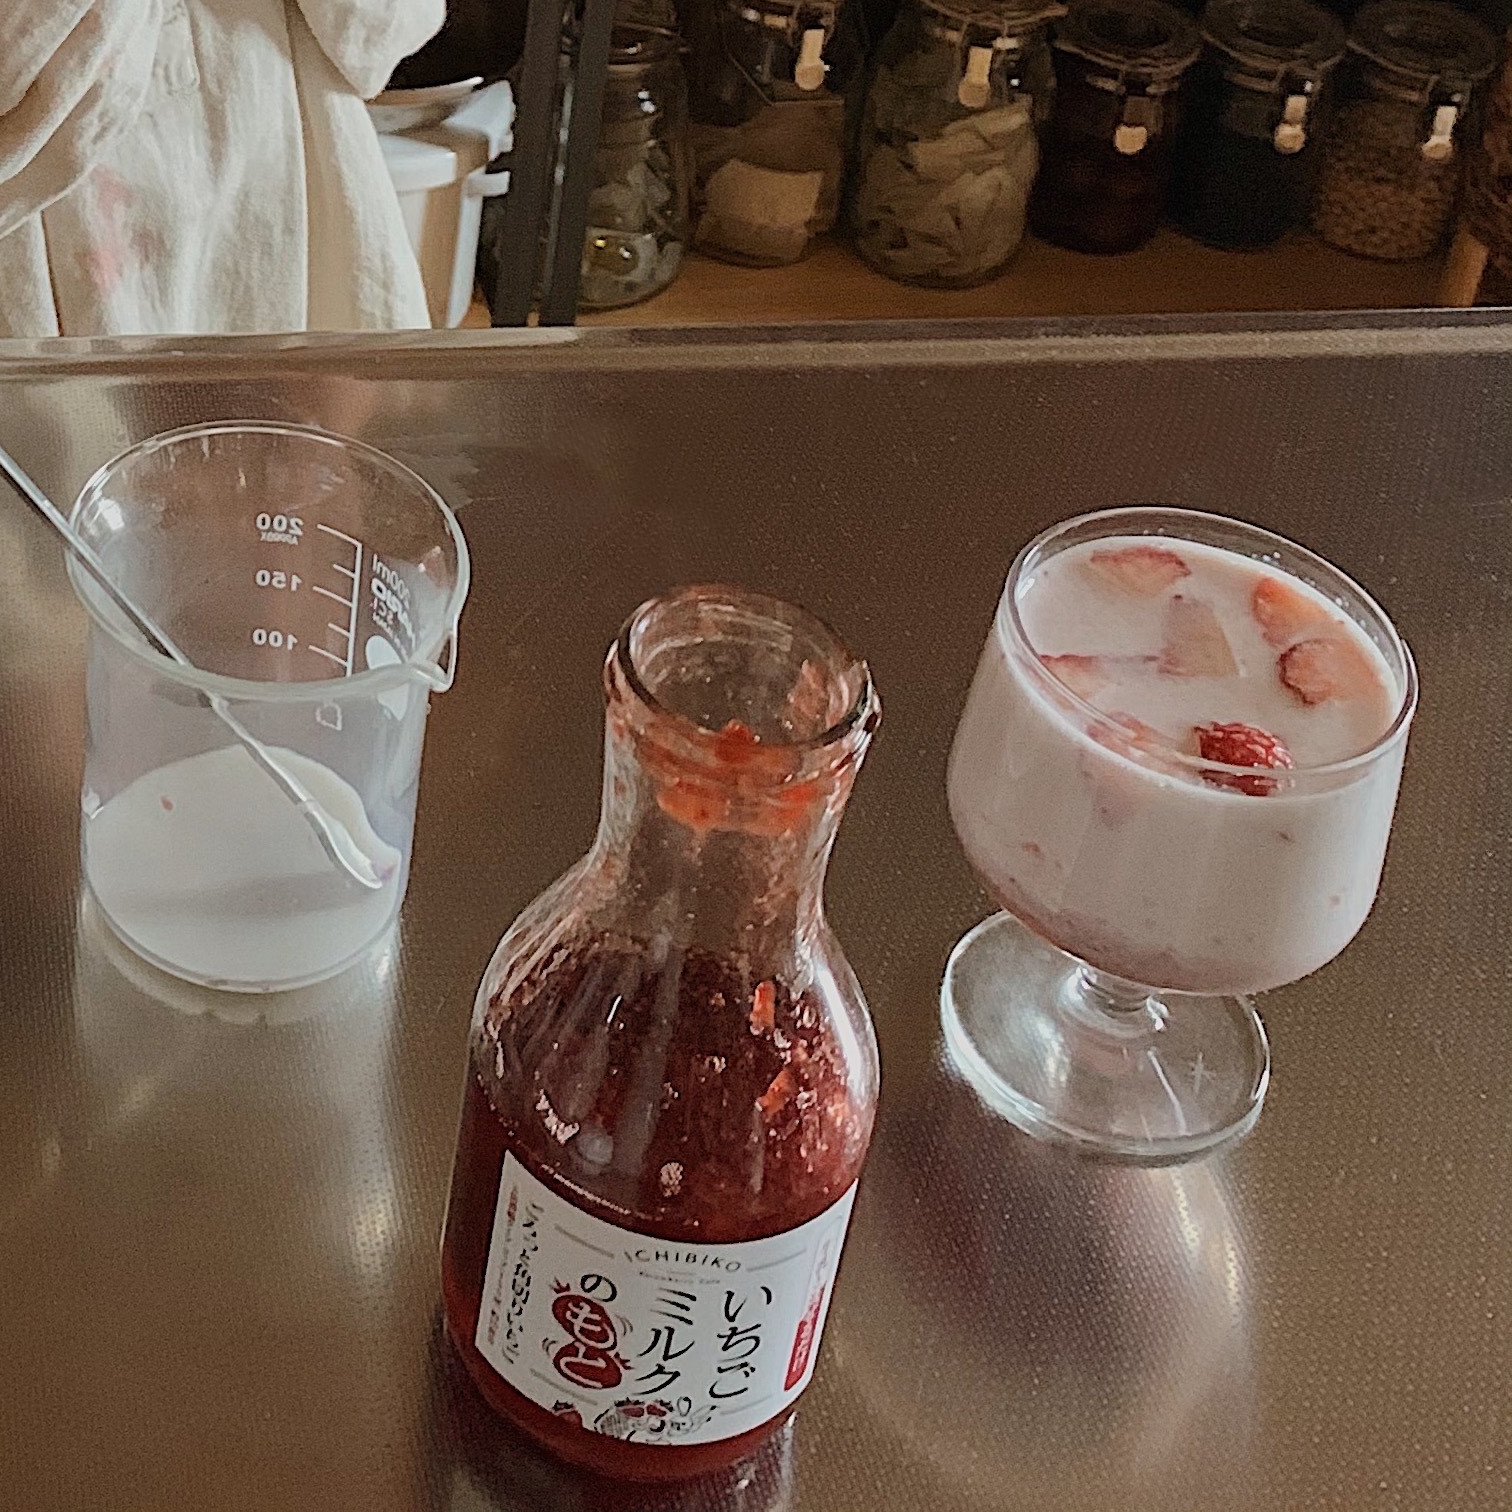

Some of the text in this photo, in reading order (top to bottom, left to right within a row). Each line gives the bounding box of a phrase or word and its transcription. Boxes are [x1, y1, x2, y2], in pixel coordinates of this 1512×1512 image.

[624, 1249, 741, 1272] ICHIBIKO
[634, 1288, 698, 1395] ミルク
[708, 1286, 772, 1399] いちご
